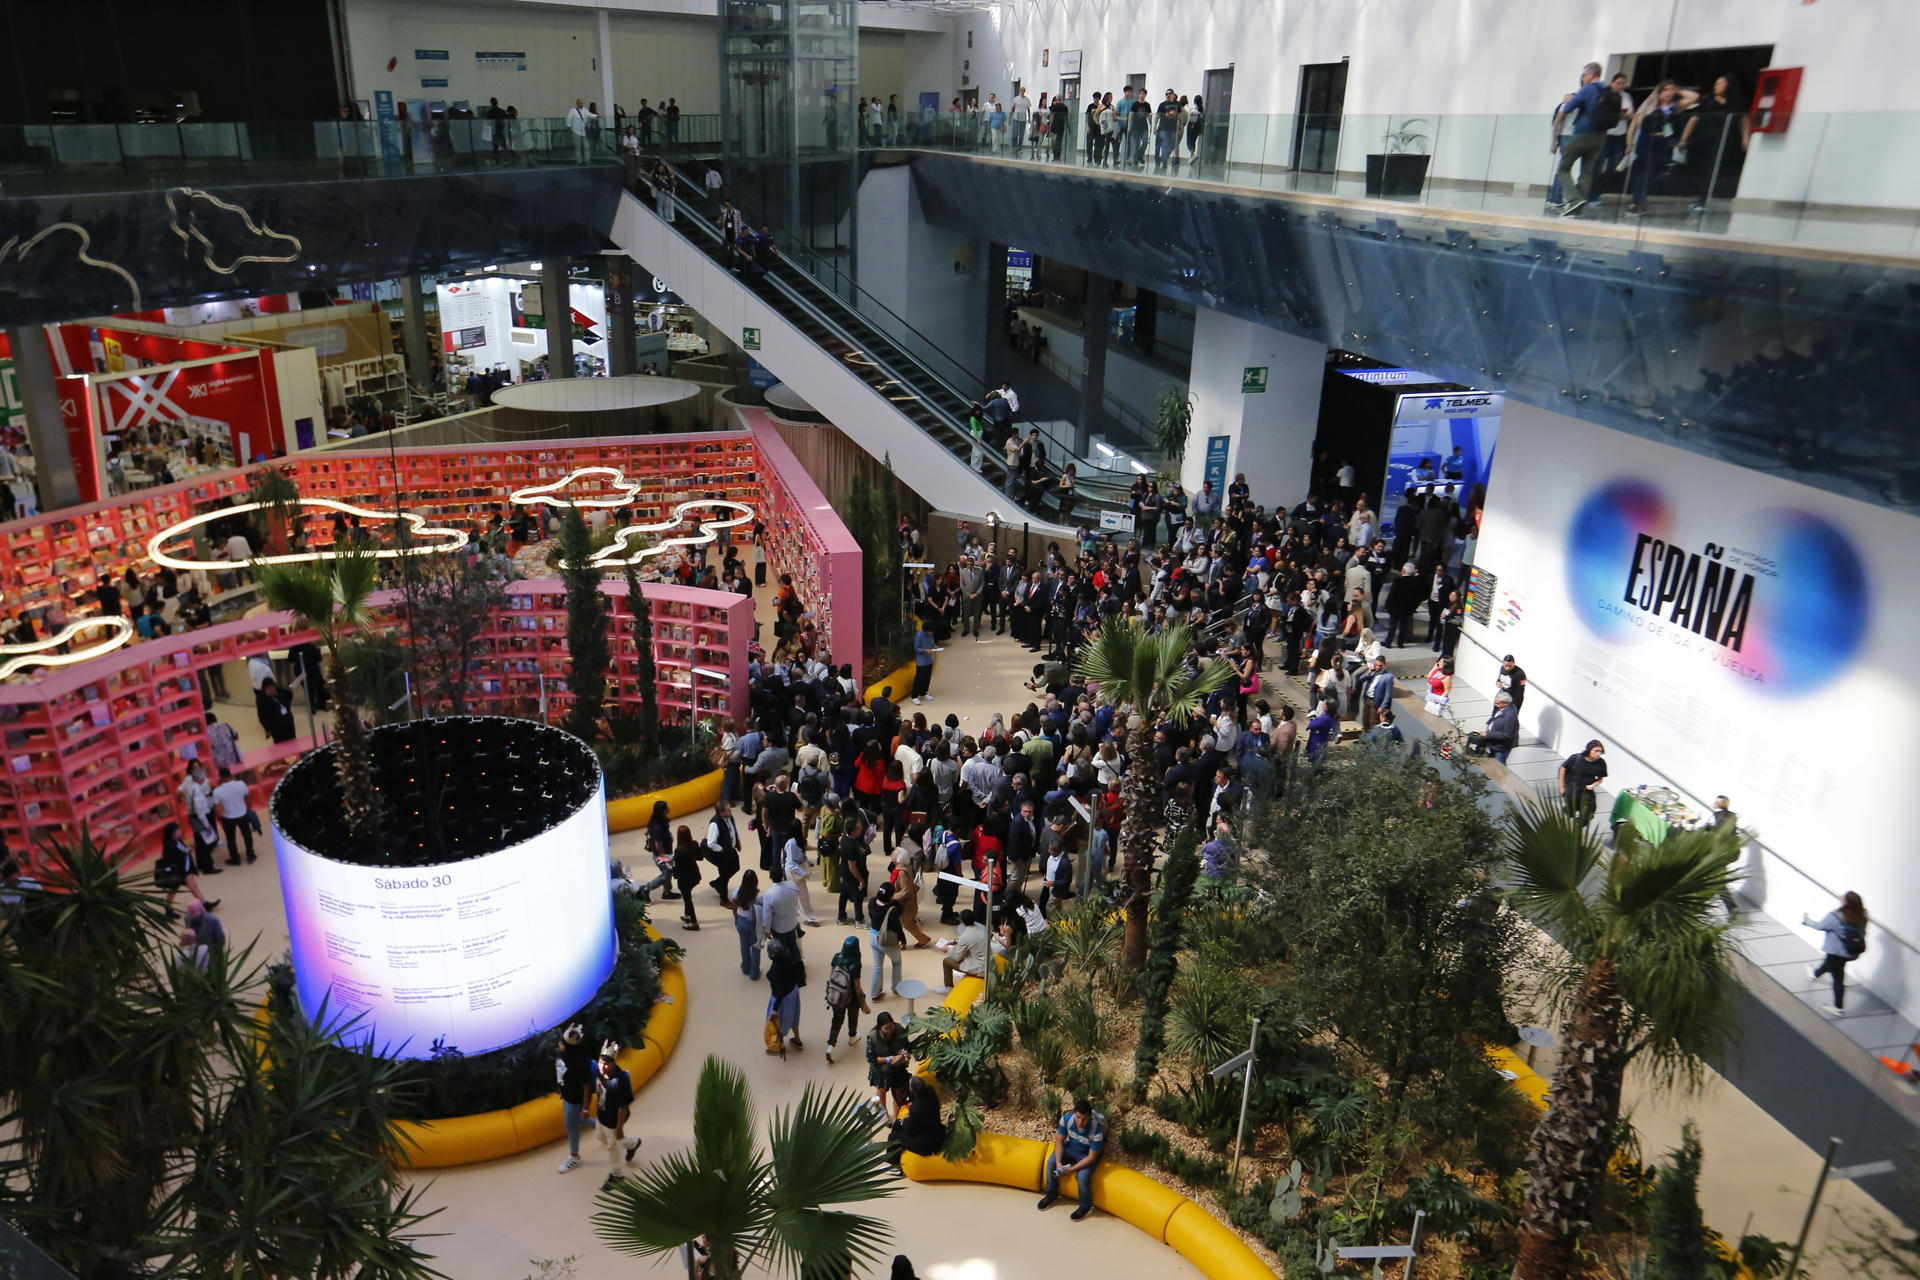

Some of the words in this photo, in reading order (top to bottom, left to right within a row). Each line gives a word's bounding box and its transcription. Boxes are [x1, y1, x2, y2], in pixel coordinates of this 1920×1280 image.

[1623, 532, 1756, 653] ESPAÑA
[1597, 599, 1643, 627] CAMINO
[1647, 622, 1665, 637] DE
[1669, 633, 1690, 648] IDA
[1712, 651, 1766, 682] VUELTA
[374, 877, 429, 890] Sábado
[432, 874, 452, 888] 30
